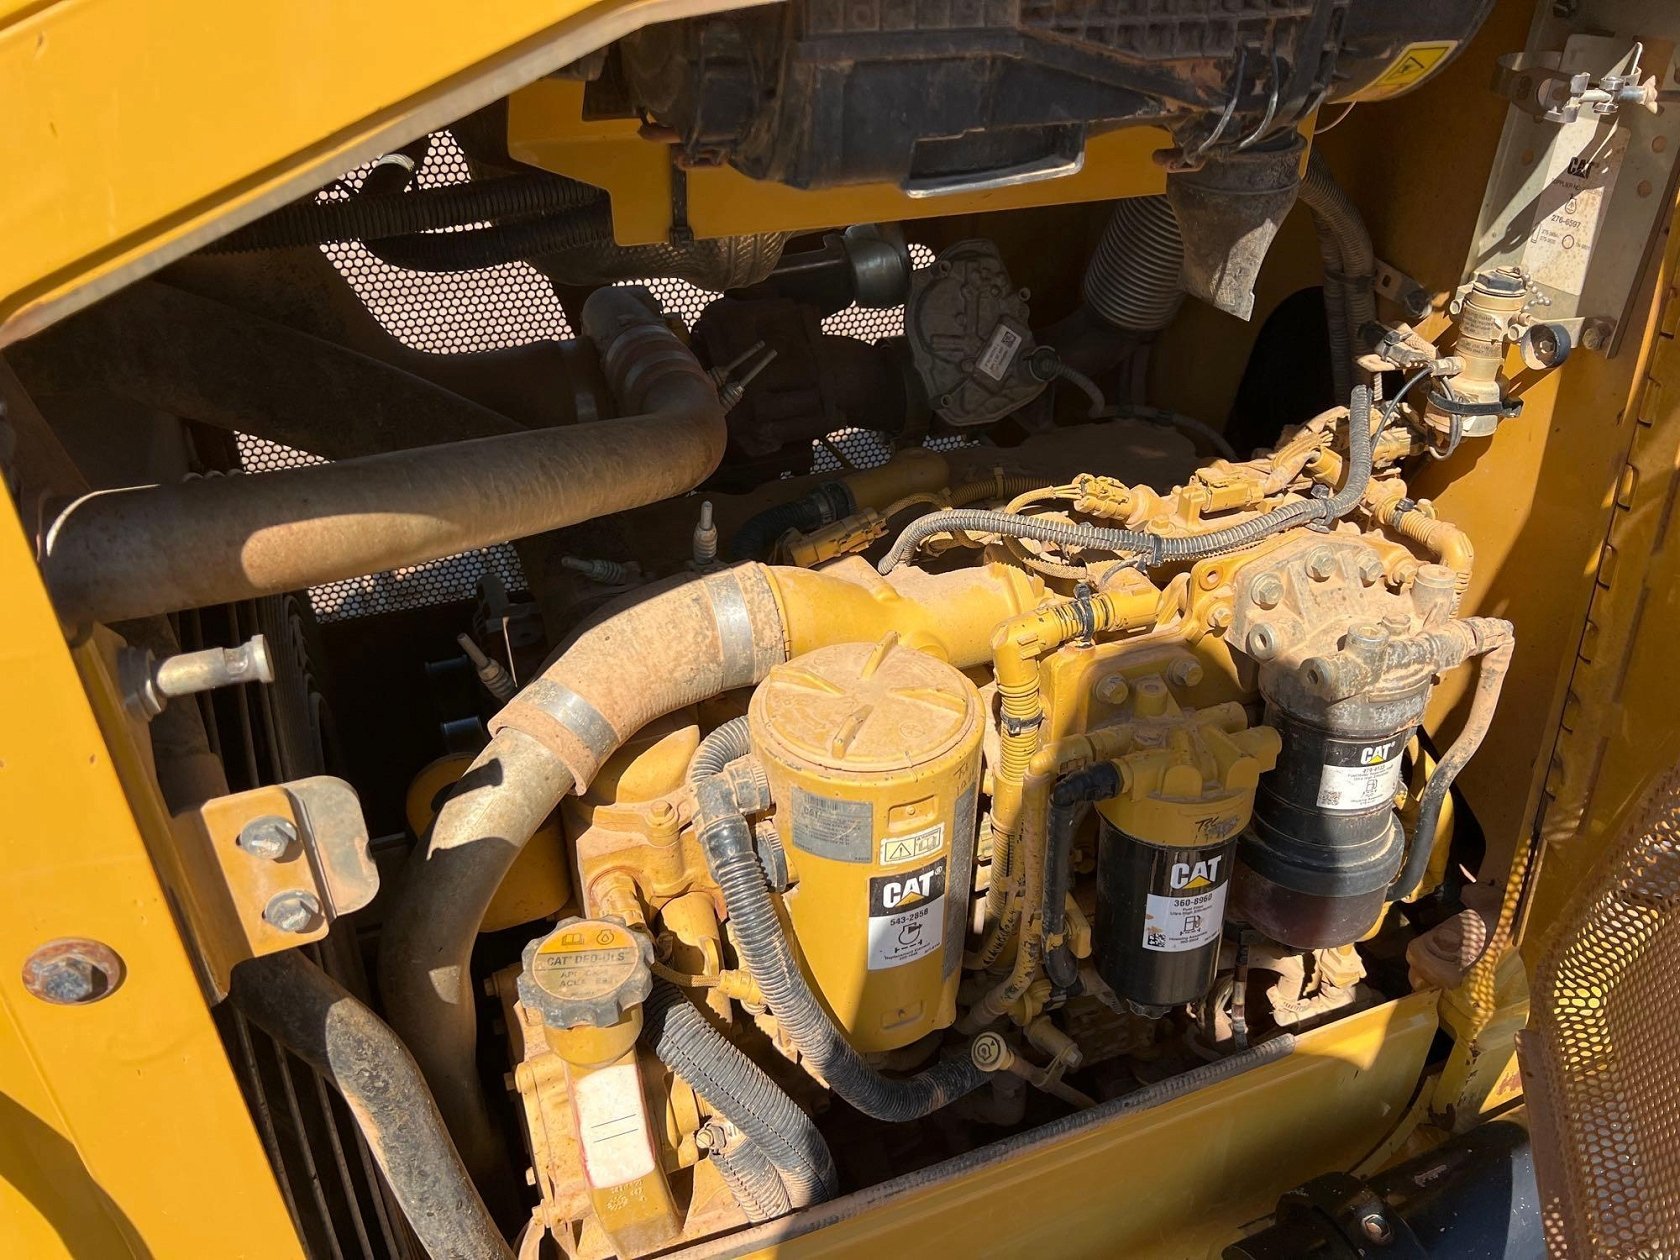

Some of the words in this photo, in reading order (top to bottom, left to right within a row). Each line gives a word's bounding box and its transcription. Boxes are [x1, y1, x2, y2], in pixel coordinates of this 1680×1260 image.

[1551, 214, 1582, 229] 276-6597
[1360, 742, 1390, 765] CAT
[1170, 855, 1222, 890] CAT
[883, 871, 934, 909] CAT
